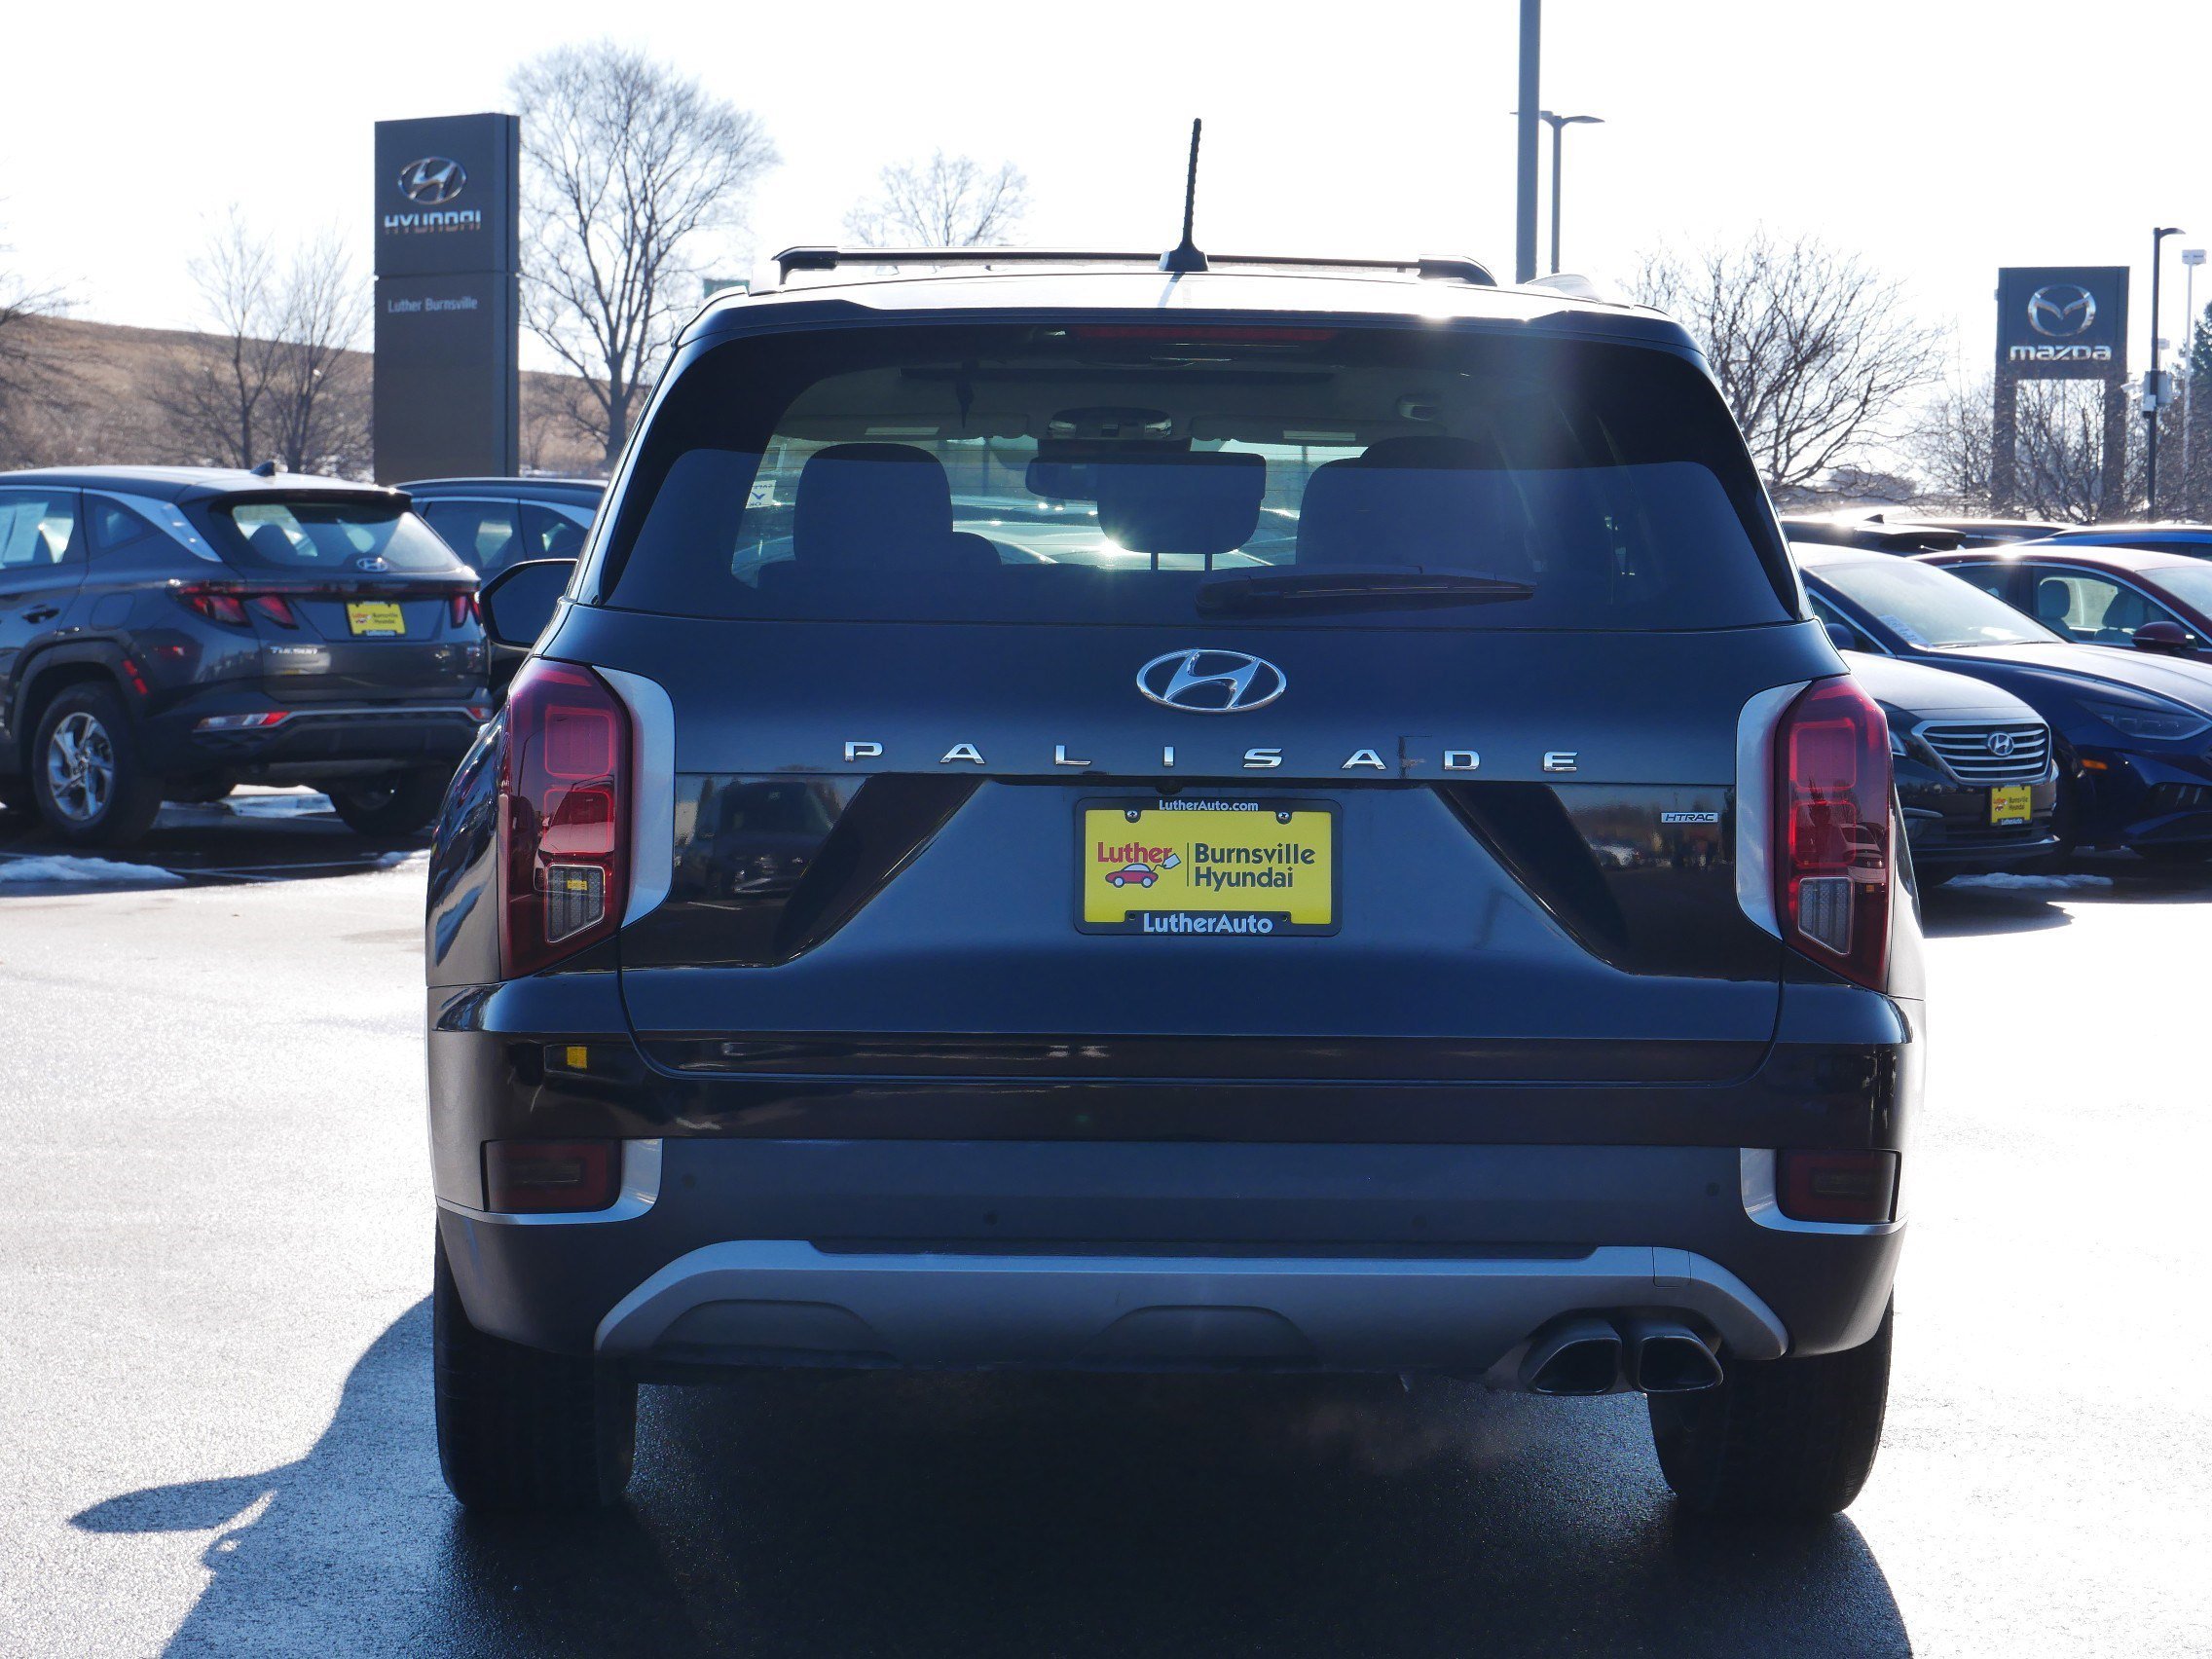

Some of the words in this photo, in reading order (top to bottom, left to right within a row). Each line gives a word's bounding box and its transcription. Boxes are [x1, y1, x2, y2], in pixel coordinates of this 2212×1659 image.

[384, 209, 482, 234] HYUNDAI
[387, 299, 422, 313] Luther
[424, 296, 478, 312] Burnsville
[844, 740, 1578, 772] PALISADE
[1159, 799, 1259, 812] LutherAuto.com
[1665, 813, 1714, 822] HTRAC
[1097, 841, 1173, 864] Luther
[1195, 842, 1316, 865] Burnsville
[1195, 866, 1294, 892] Hyundai
[1143, 912, 1273, 934] LutherAuto
